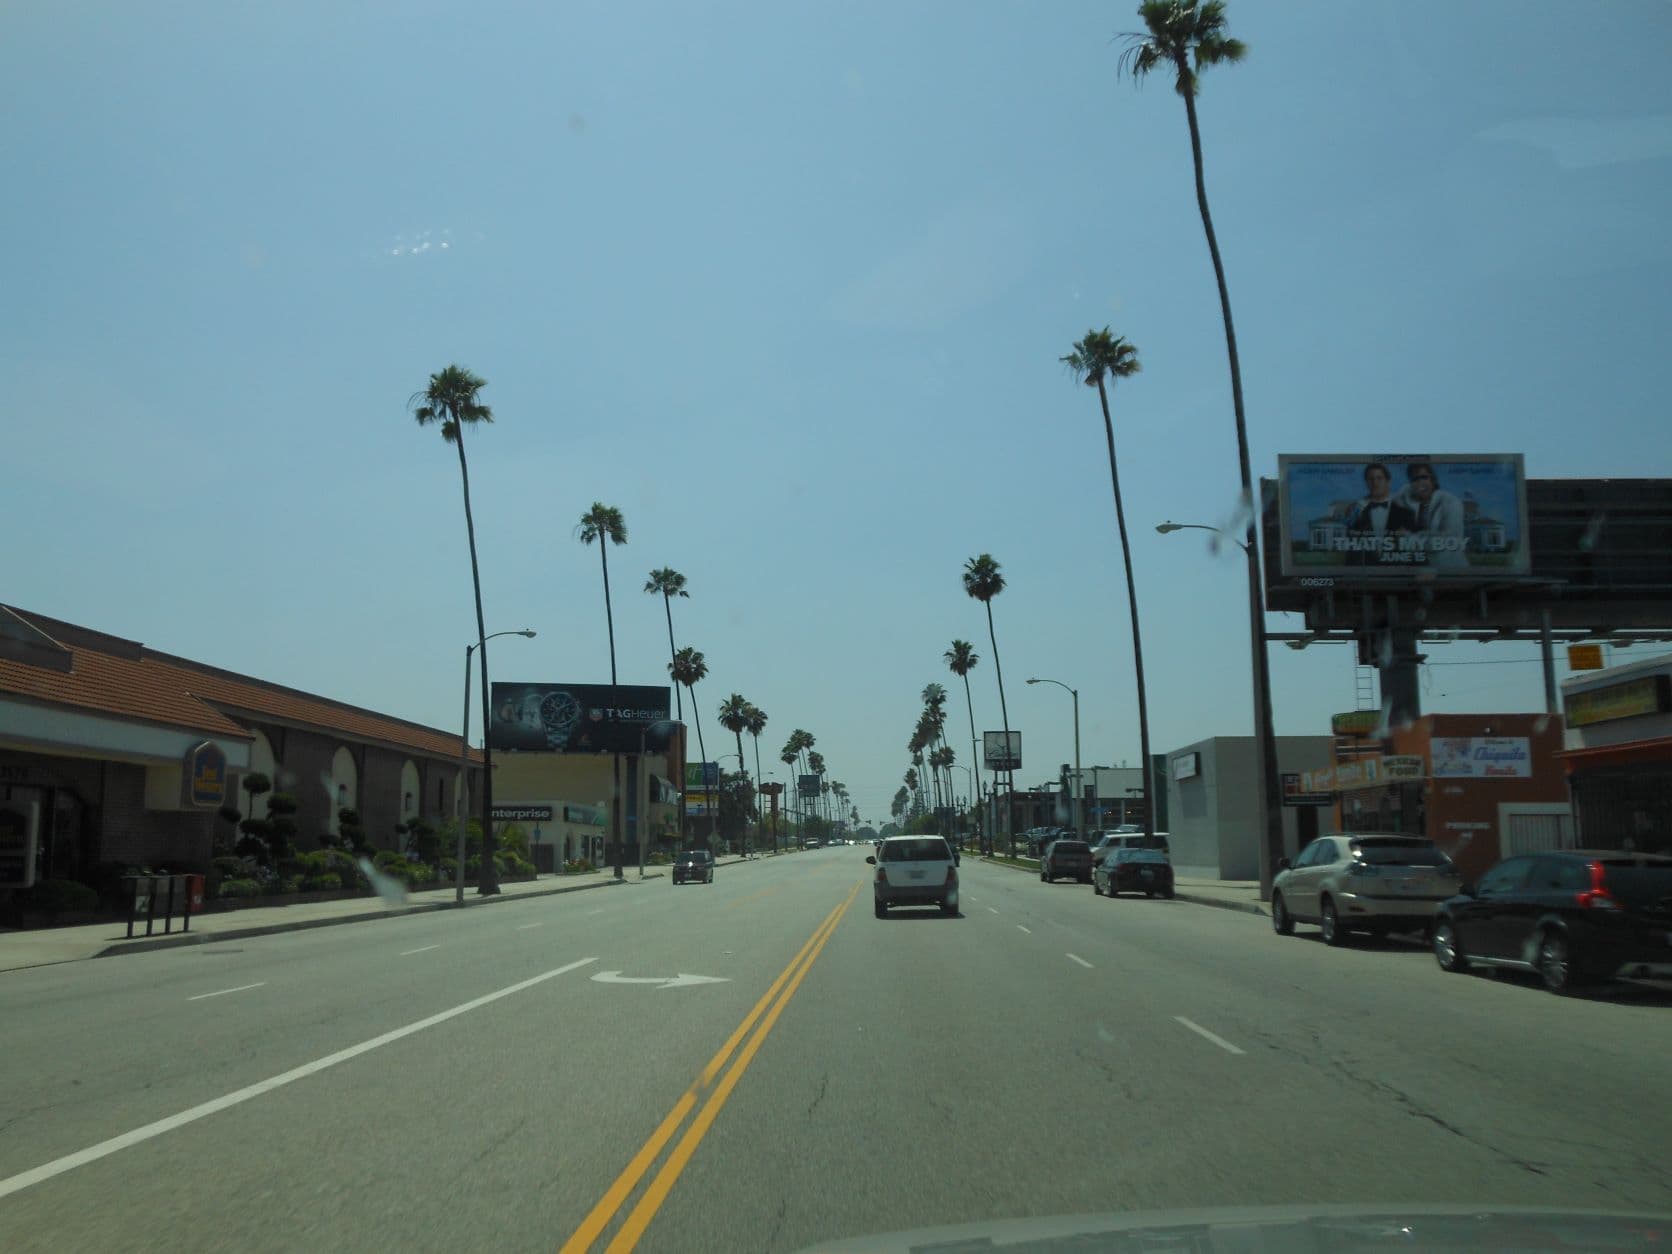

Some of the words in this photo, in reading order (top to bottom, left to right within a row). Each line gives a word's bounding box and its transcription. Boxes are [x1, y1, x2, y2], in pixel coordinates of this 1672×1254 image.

[1334, 535, 1395, 551] THAT'S
[1398, 536, 1427, 551] MY
[1431, 536, 1471, 551] BOY
[1379, 551, 1412, 562] JUNE
[491, 808, 550, 820] nterprise
